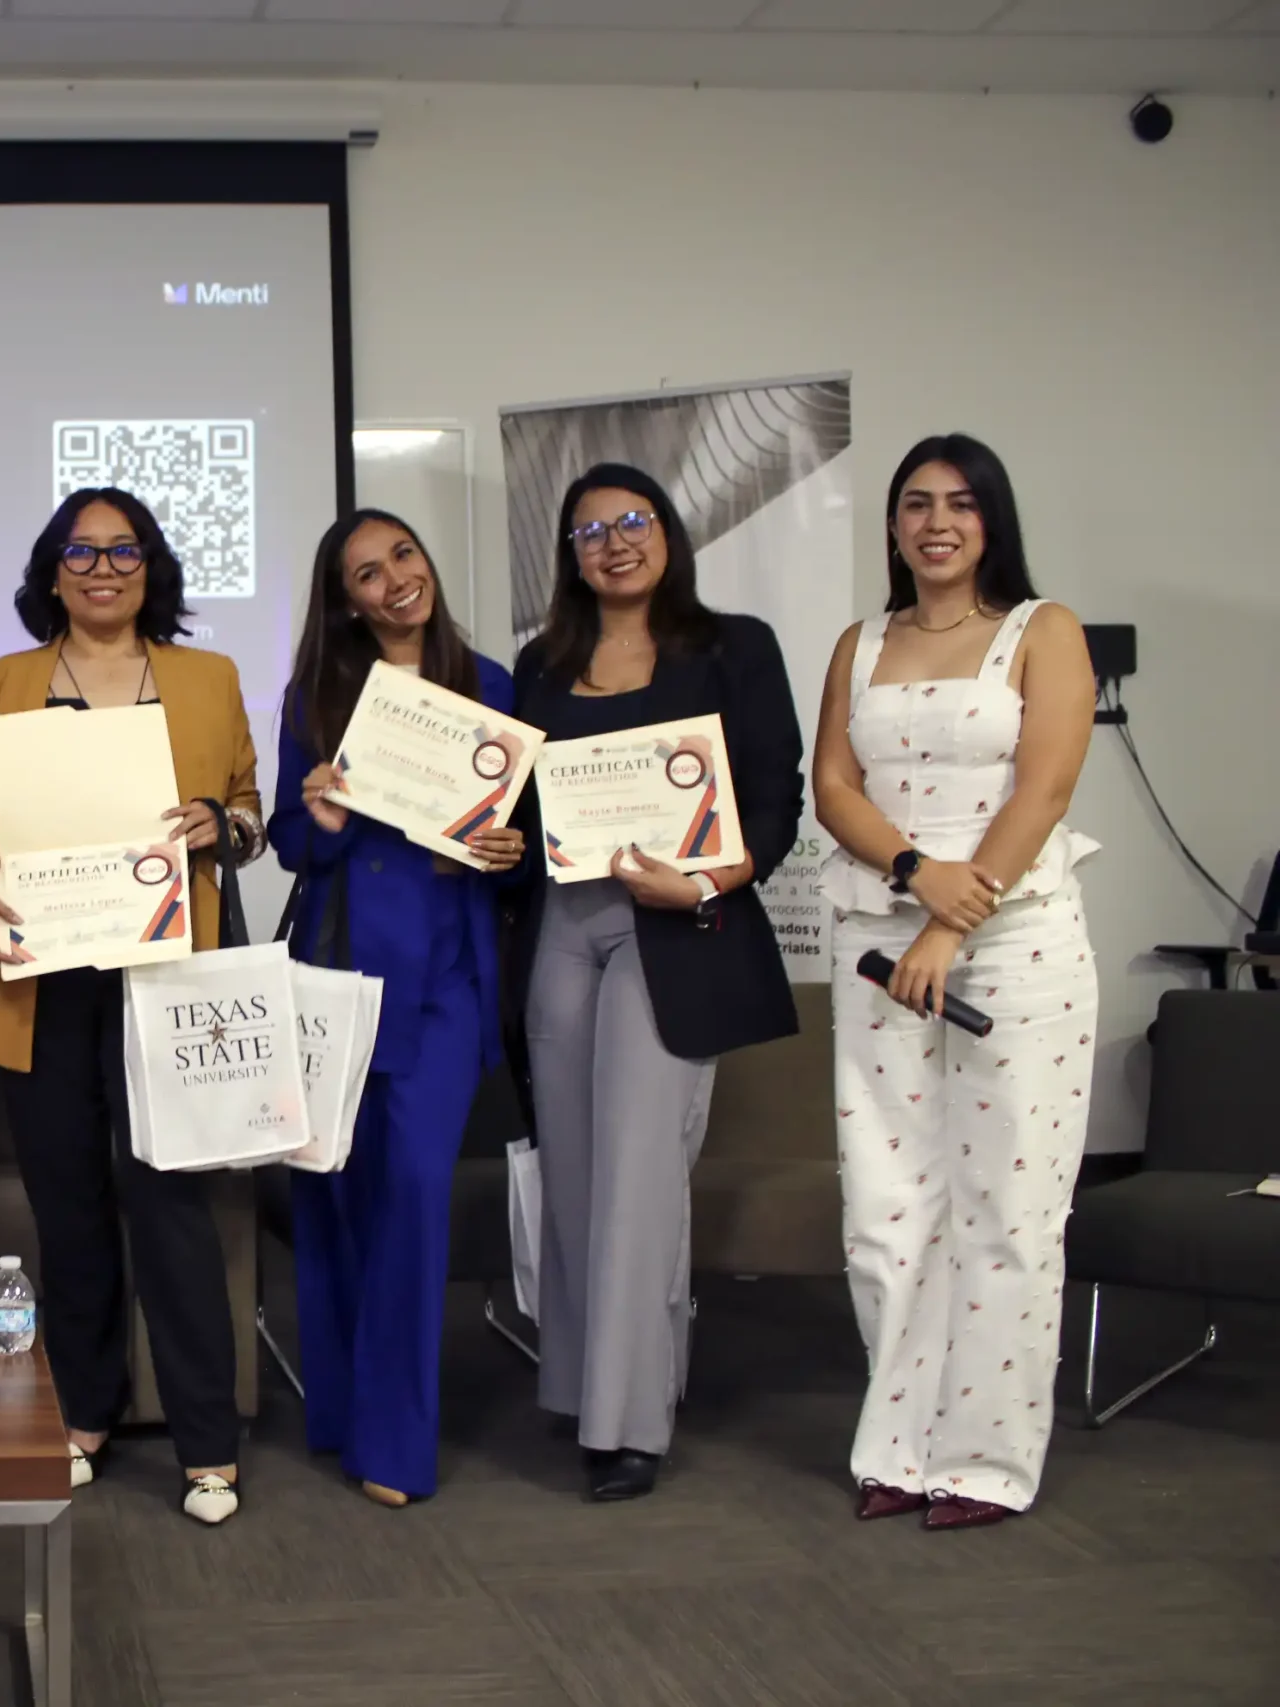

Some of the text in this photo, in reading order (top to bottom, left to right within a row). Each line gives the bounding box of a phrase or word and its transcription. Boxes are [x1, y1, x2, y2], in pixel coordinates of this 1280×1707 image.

[195, 282, 268, 304] Menti
[551, 758, 656, 778] CERTIFICATE
[779, 941, 821, 955] riales
[166, 994, 268, 1030] TEXAS
[175, 1035, 273, 1072] STATE
[183, 1064, 270, 1088] UNIVERSITY
